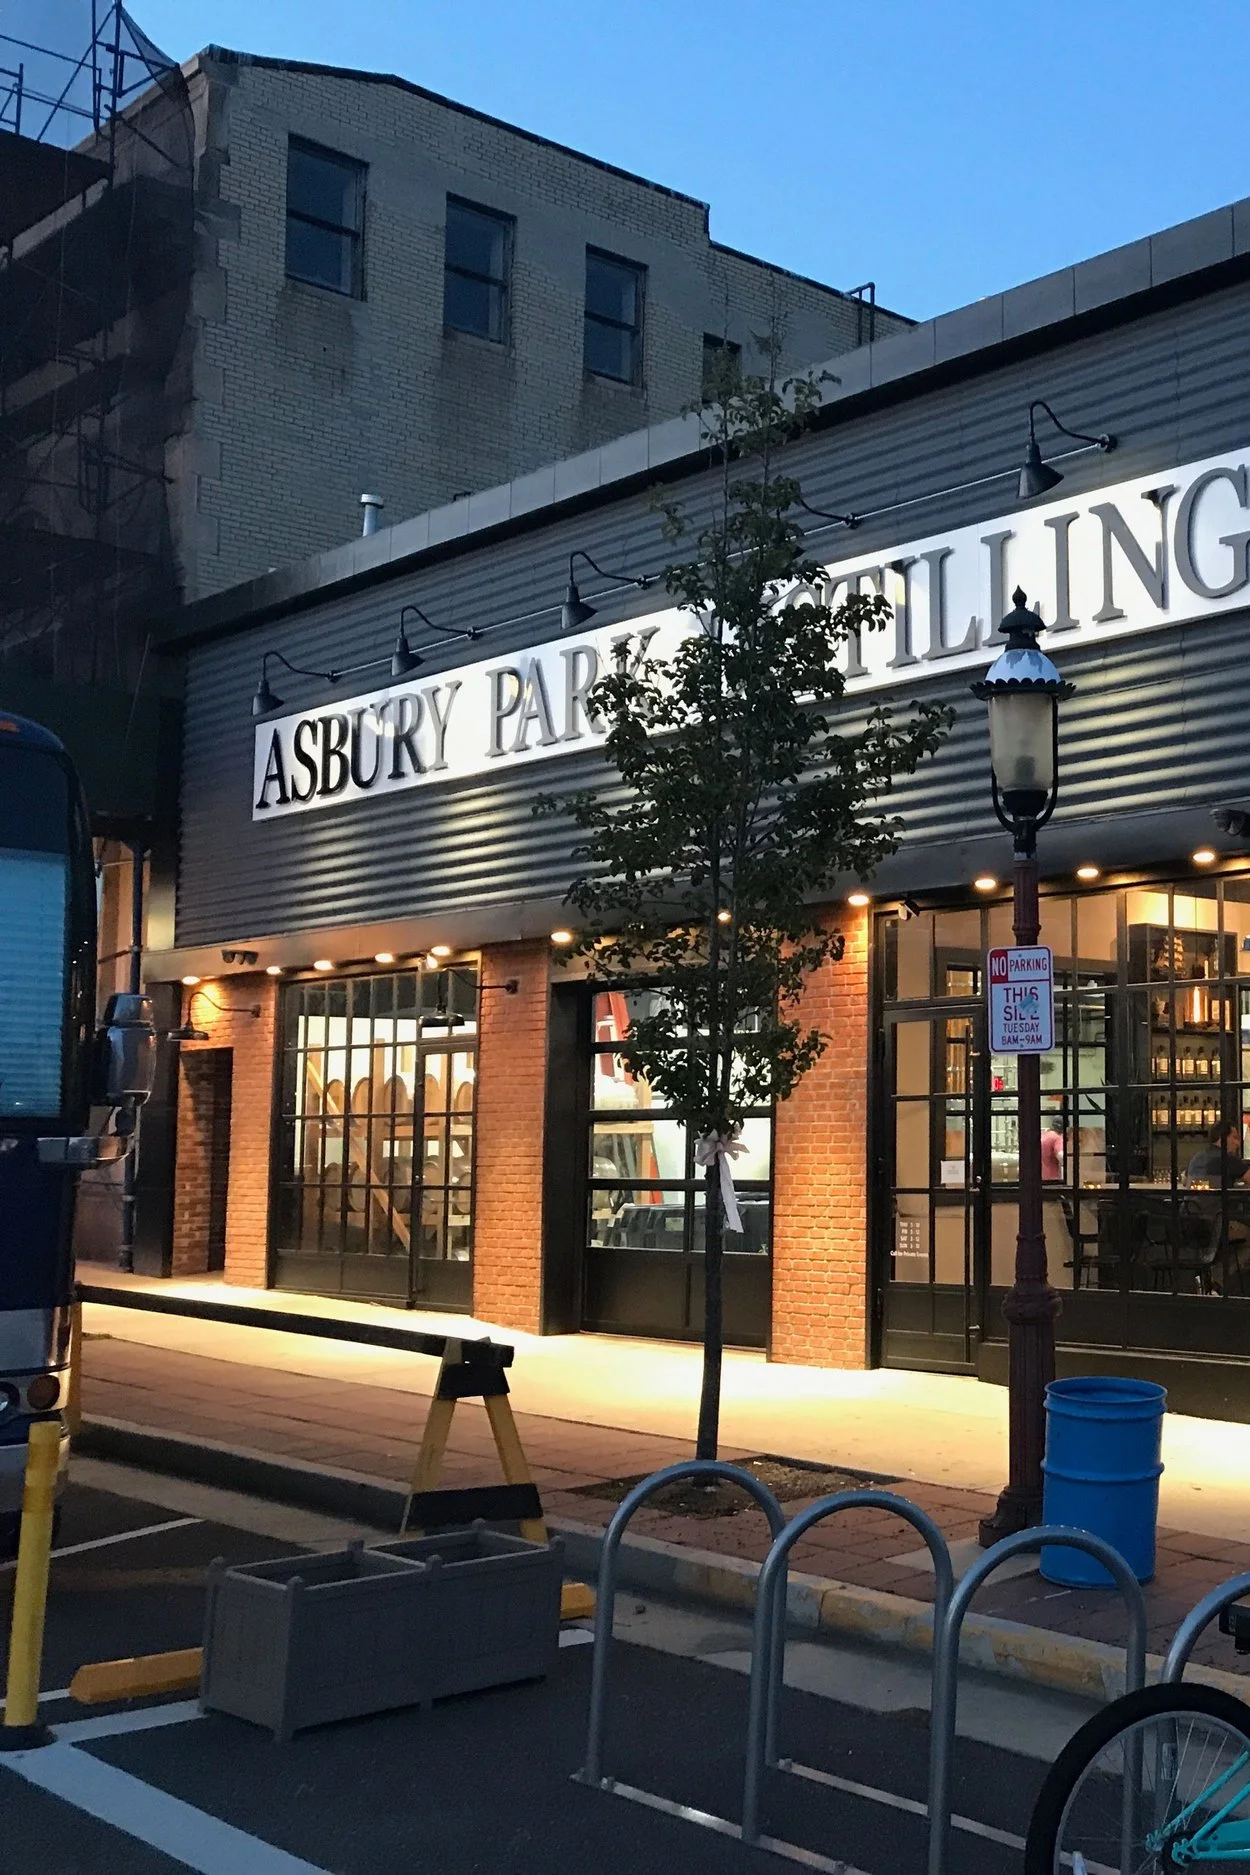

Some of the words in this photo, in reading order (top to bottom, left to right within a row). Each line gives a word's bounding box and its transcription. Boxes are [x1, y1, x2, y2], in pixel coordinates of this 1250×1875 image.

[255, 680, 463, 810] ASBURY
[485, 624, 662, 758] PARK
[991, 956, 1007, 977] NO
[1009, 957, 1048, 972] PARKING
[1003, 986, 1039, 1003] THIS
[1003, 1022, 1040, 1034] TUESDAY
